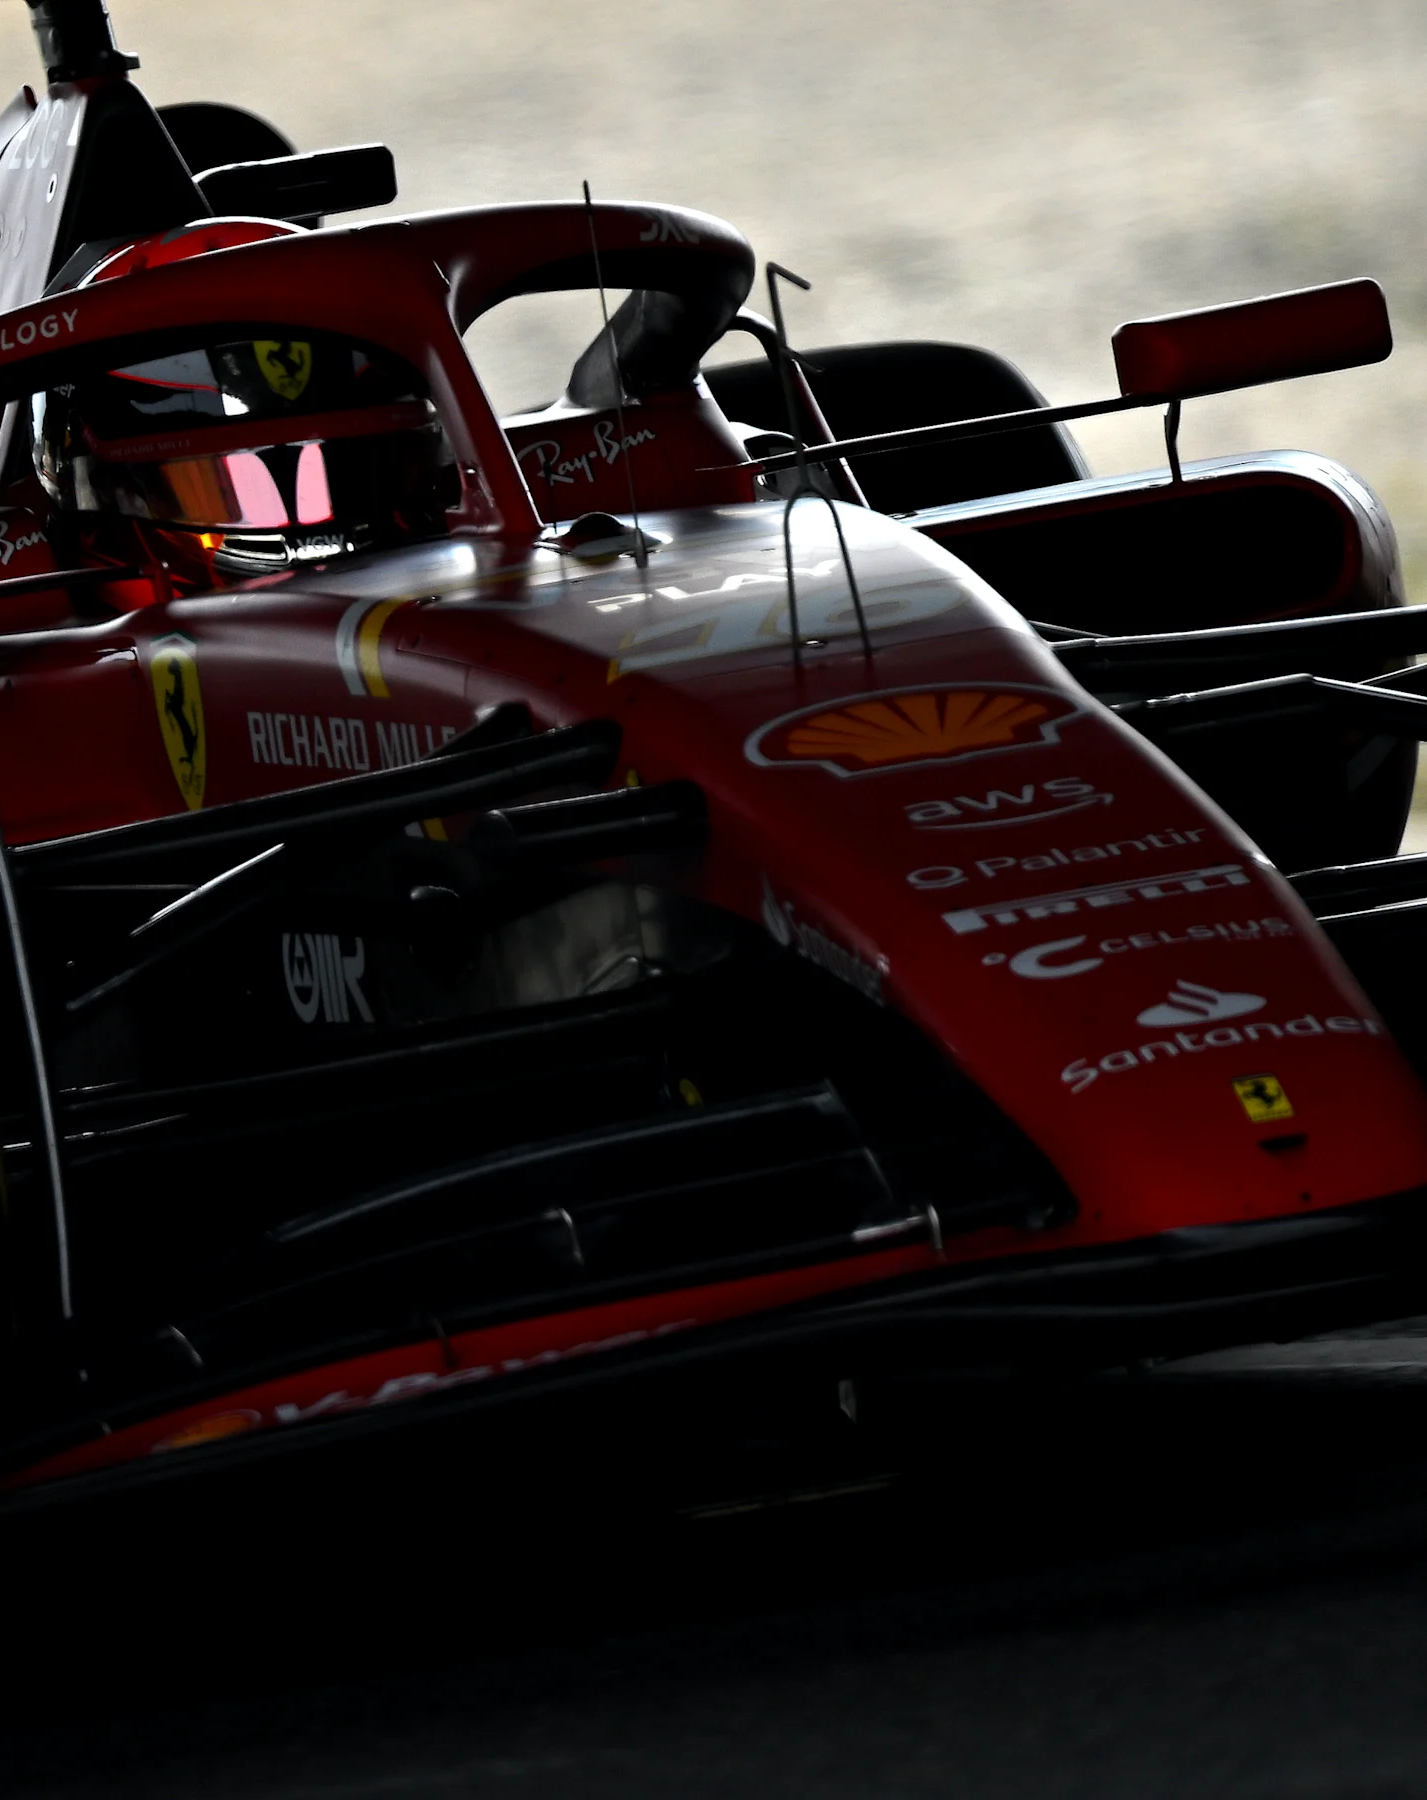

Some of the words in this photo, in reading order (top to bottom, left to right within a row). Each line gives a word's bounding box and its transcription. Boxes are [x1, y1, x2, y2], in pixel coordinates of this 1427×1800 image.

[246, 711, 370, 772] RICHARD
[904, 776, 1098, 826] aws
[974, 827, 1208, 880] Palantir
[940, 863, 1252, 936] PIRELLI
[1098, 916, 1292, 956] CELSIUS
[1059, 1012, 1382, 1096] Santander
